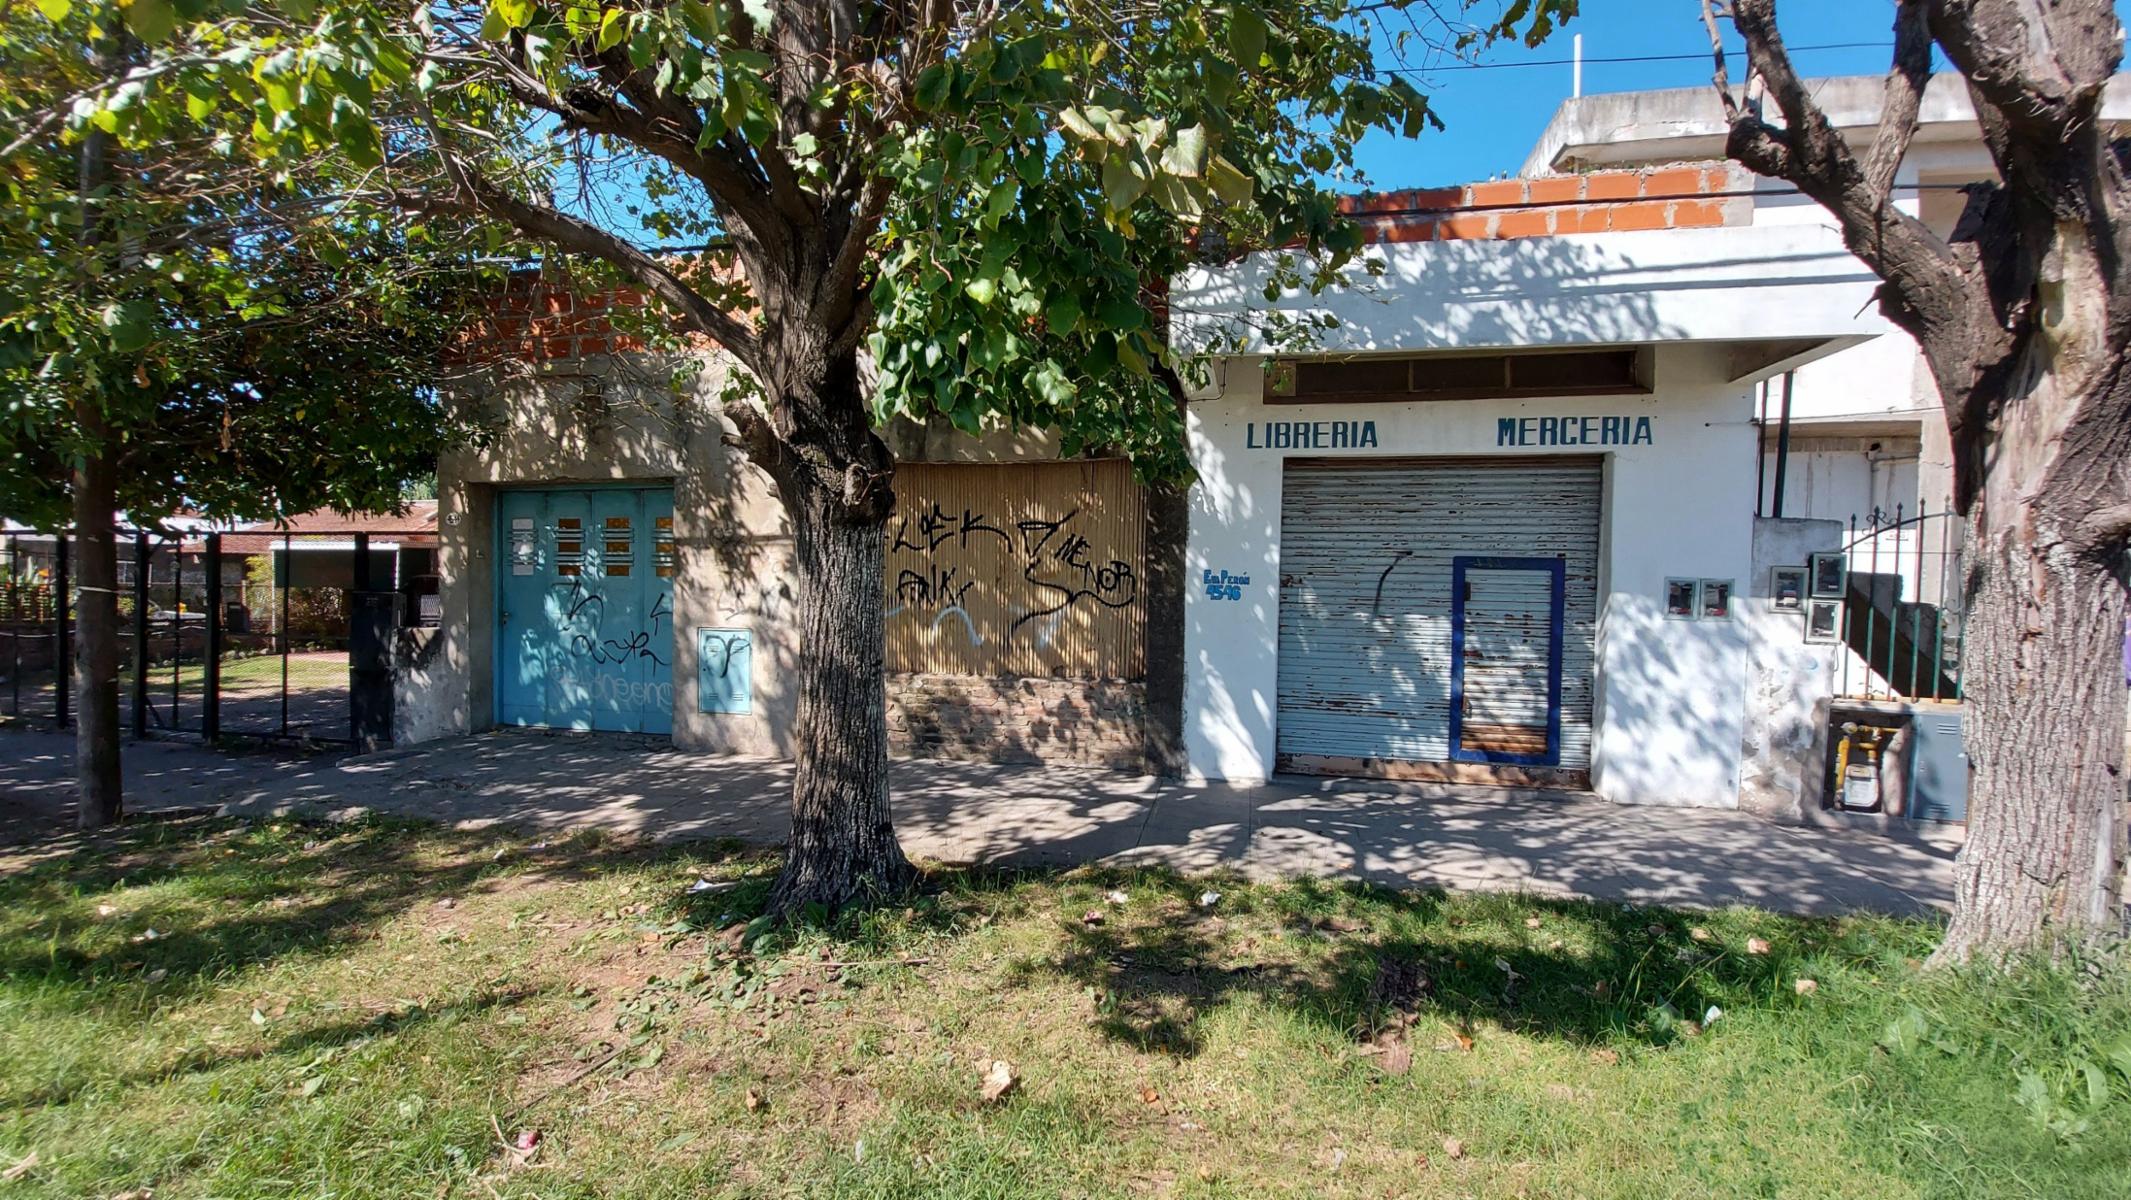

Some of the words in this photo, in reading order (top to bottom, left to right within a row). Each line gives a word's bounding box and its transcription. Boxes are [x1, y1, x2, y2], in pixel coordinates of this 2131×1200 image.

[1247, 421, 1378, 449] LIBRERIA
[1497, 416, 1653, 446] MERCERIA
[1205, 584, 1242, 601] 4546
